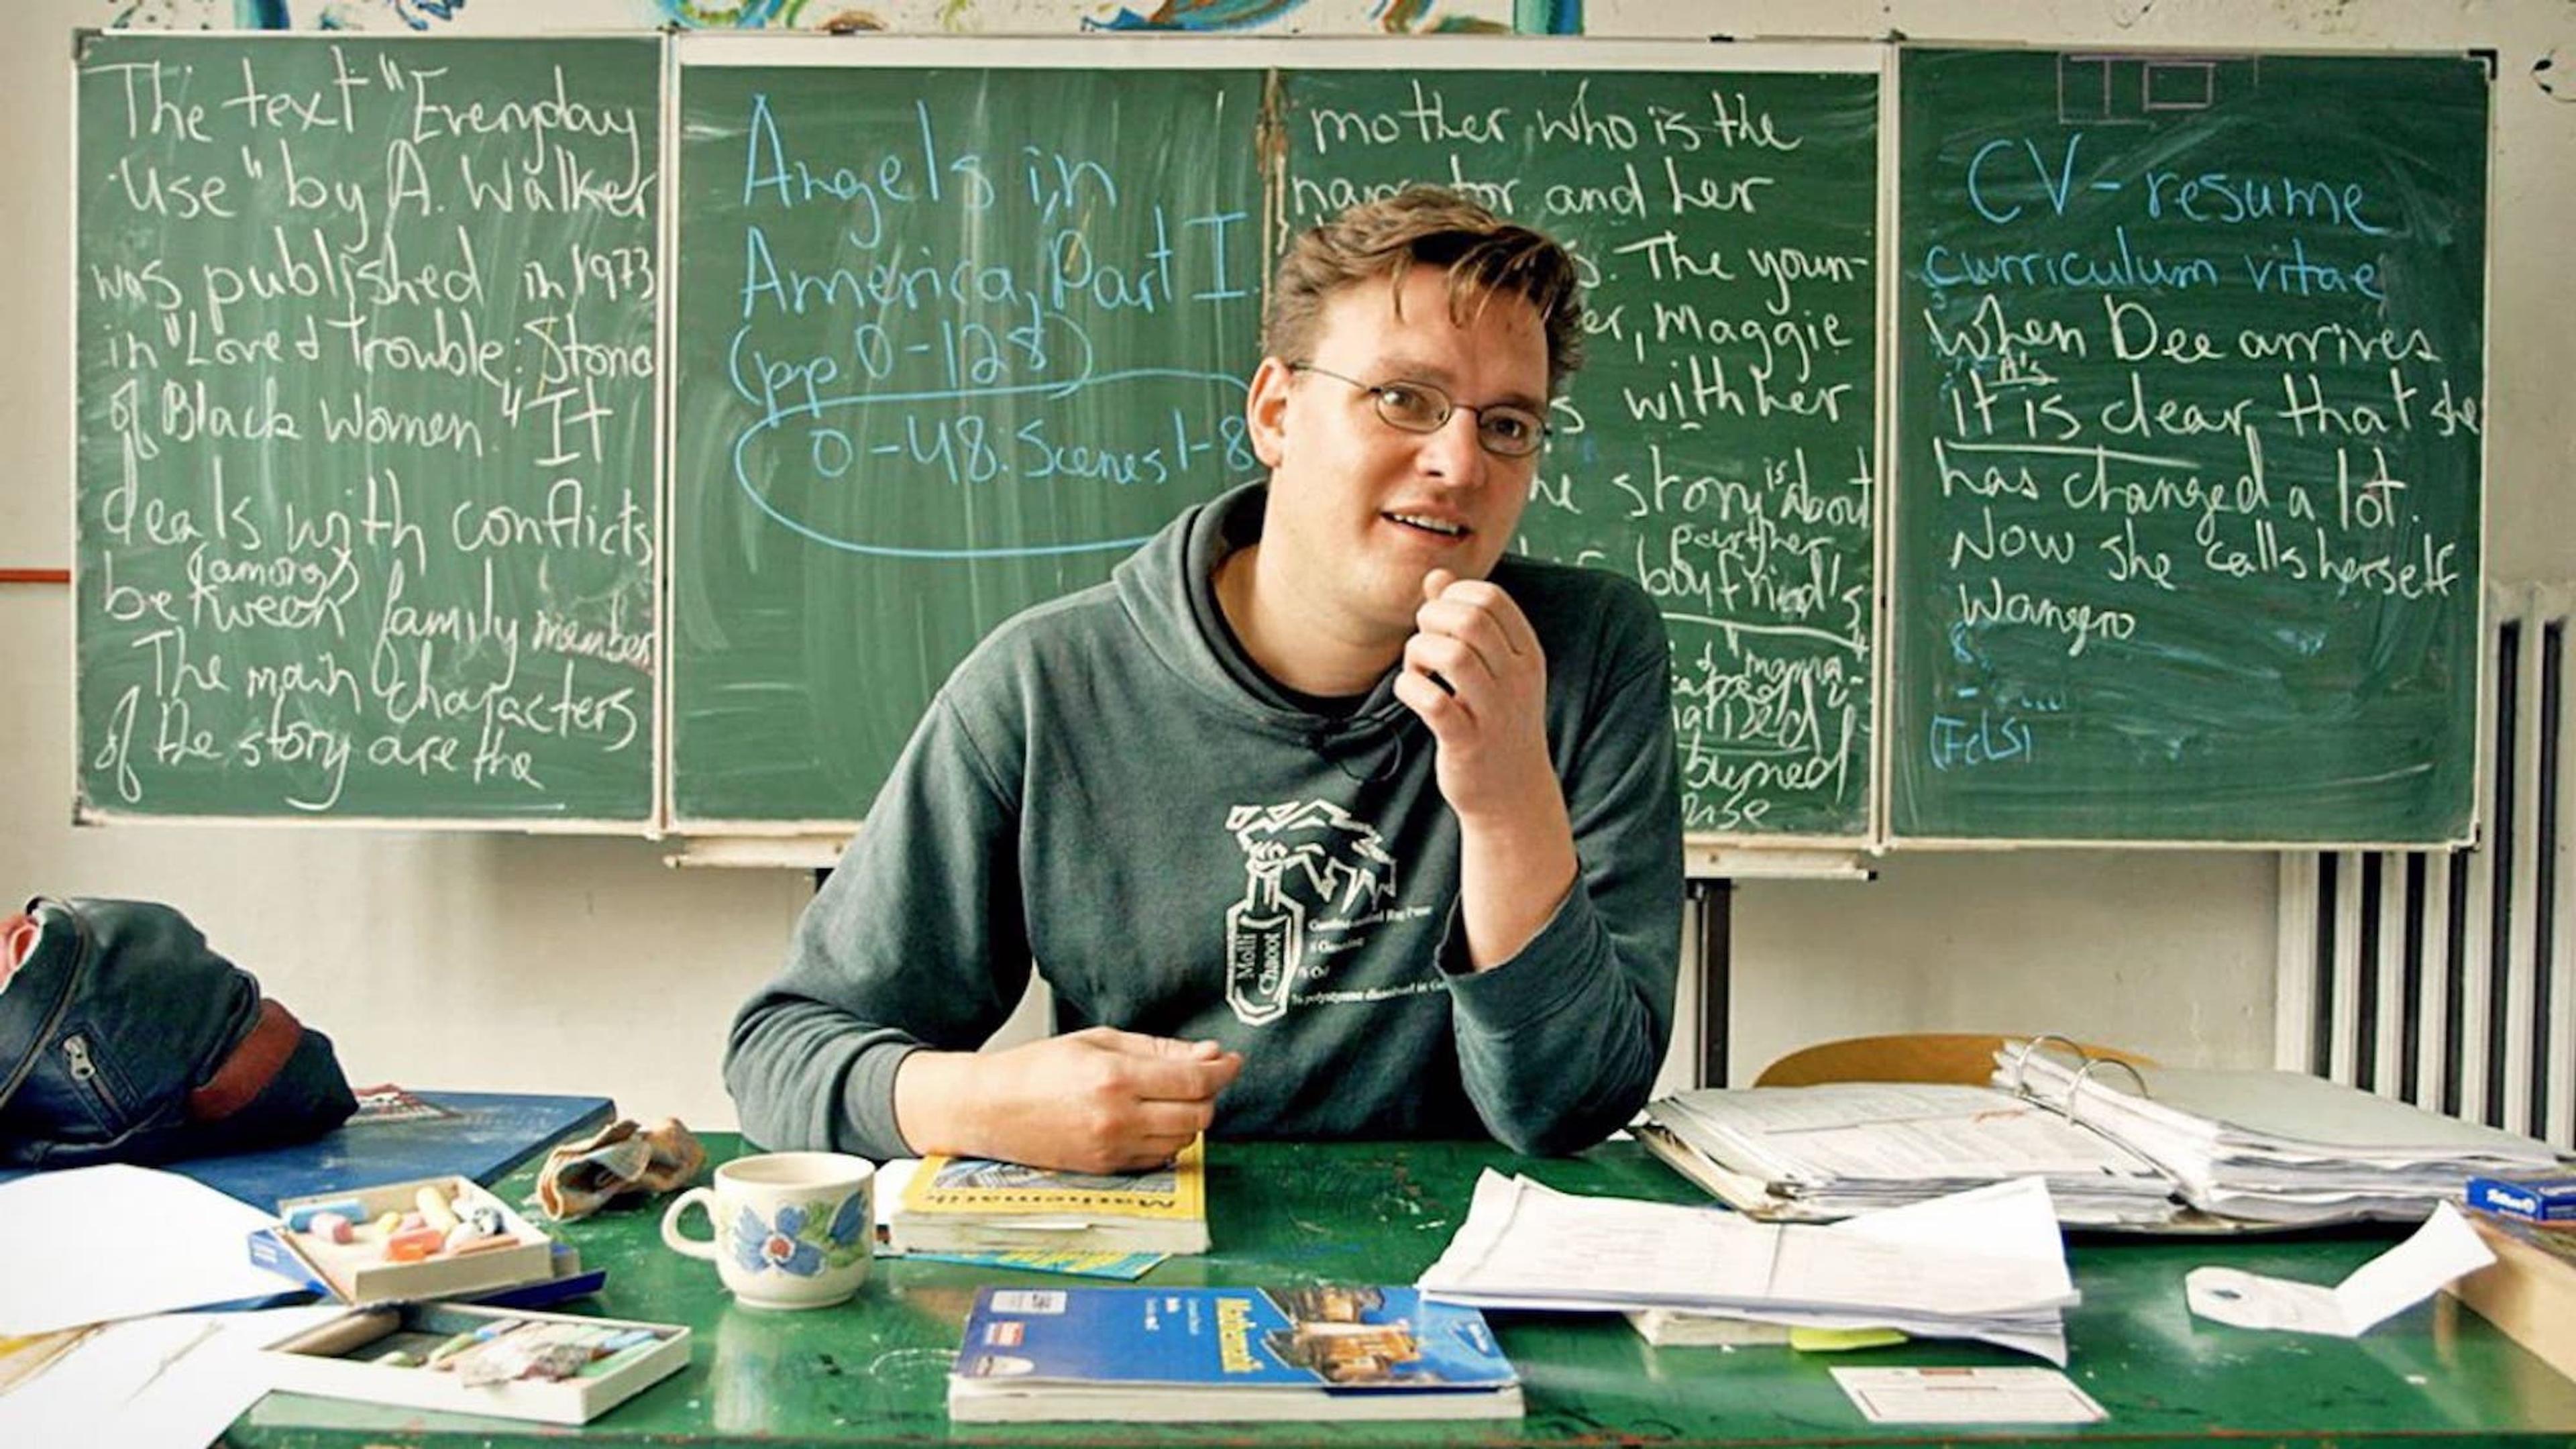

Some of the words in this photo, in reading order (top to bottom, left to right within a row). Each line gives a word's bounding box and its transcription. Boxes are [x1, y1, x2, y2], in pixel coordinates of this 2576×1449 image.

[85, 60, 211, 142] The
[222, 45, 369, 133] text
[1310, 80, 1510, 154] mother
[1537, 80, 1638, 150] who
[1648, 106, 1700, 150] is
[1711, 90, 1804, 150] the
[280, 139, 367, 254] by
[385, 140, 445, 216] A.
[462, 144, 657, 218] Walker
[744, 94, 996, 250] Angels
[1547, 162, 1646, 219] and
[1666, 158, 1774, 214] her
[1968, 133, 2082, 223] CV
[2147, 170, 2411, 238] resume
[93, 259, 182, 311] was
[205, 225, 484, 336] published
[524, 261, 566, 300] in
[572, 244, 654, 300] 1973
[1051, 206, 1173, 314] Part
[1185, 212, 1248, 301] I
[1613, 230, 1735, 280] The
[1924, 227, 2217, 289] curriculum
[2245, 238, 2387, 300] vitae
[105, 324, 157, 369] in
[1654, 302, 1853, 382] Maggie
[1924, 294, 2086, 358] When
[2104, 295, 2228, 364] Dee
[2239, 325, 2441, 364] arrives
[111, 380, 160, 459] of
[162, 378, 302, 441] Black
[523, 376, 614, 465] It
[1623, 356, 1744, 420] with
[1750, 364, 1851, 423] her
[2026, 394, 2081, 440] is
[2277, 368, 2418, 437] that
[2430, 380, 2481, 436] she
[1017, 421, 1167, 484] Scenes
[1934, 438, 2040, 500] has
[2063, 425, 2269, 545] changed
[2288, 486, 2314, 521] a
[103, 431, 261, 549] deals
[288, 469, 425, 574] with
[454, 478, 653, 566] conflicts
[1613, 443, 1764, 574] story
[1781, 447, 1874, 529] about
[2317, 527, 2460, 598] herself
[371, 556, 518, 696] family
[132, 627, 230, 698] The
[248, 653, 360, 713] main
[388, 641, 637, 751] characters
[95, 686, 142, 802] of
[238, 693, 350, 810] story
[368, 735, 458, 774] are
[475, 725, 543, 790] the
